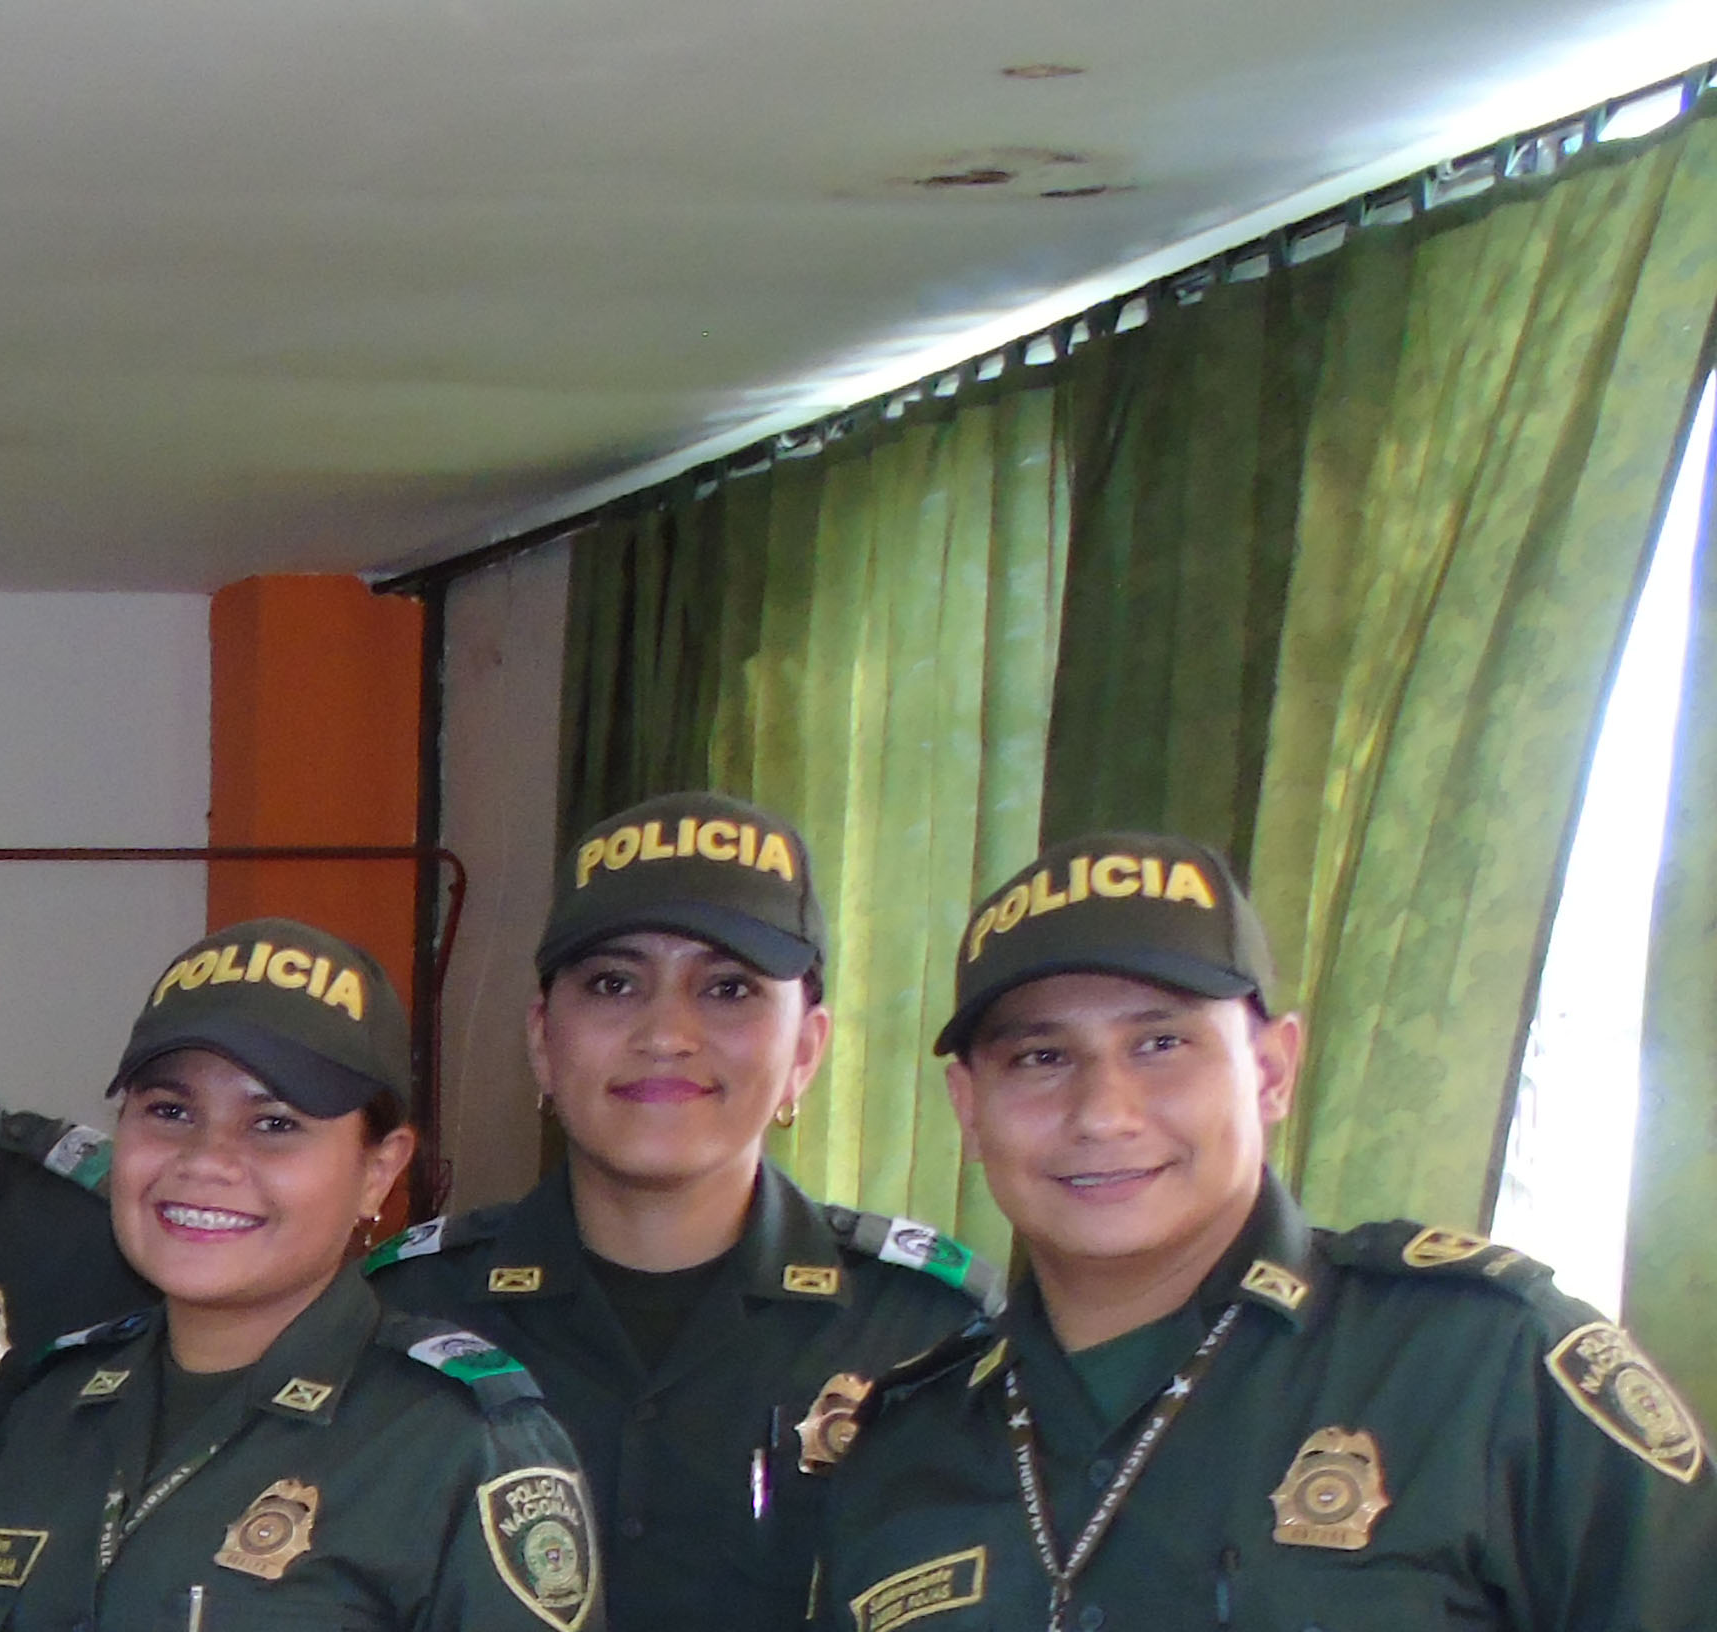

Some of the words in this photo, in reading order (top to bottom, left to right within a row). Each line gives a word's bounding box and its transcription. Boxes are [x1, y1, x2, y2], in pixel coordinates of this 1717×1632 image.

[576, 817, 796, 889] POLICIA
[967, 854, 1214, 963] POLICIA
[152, 942, 364, 1021] POLICIA
